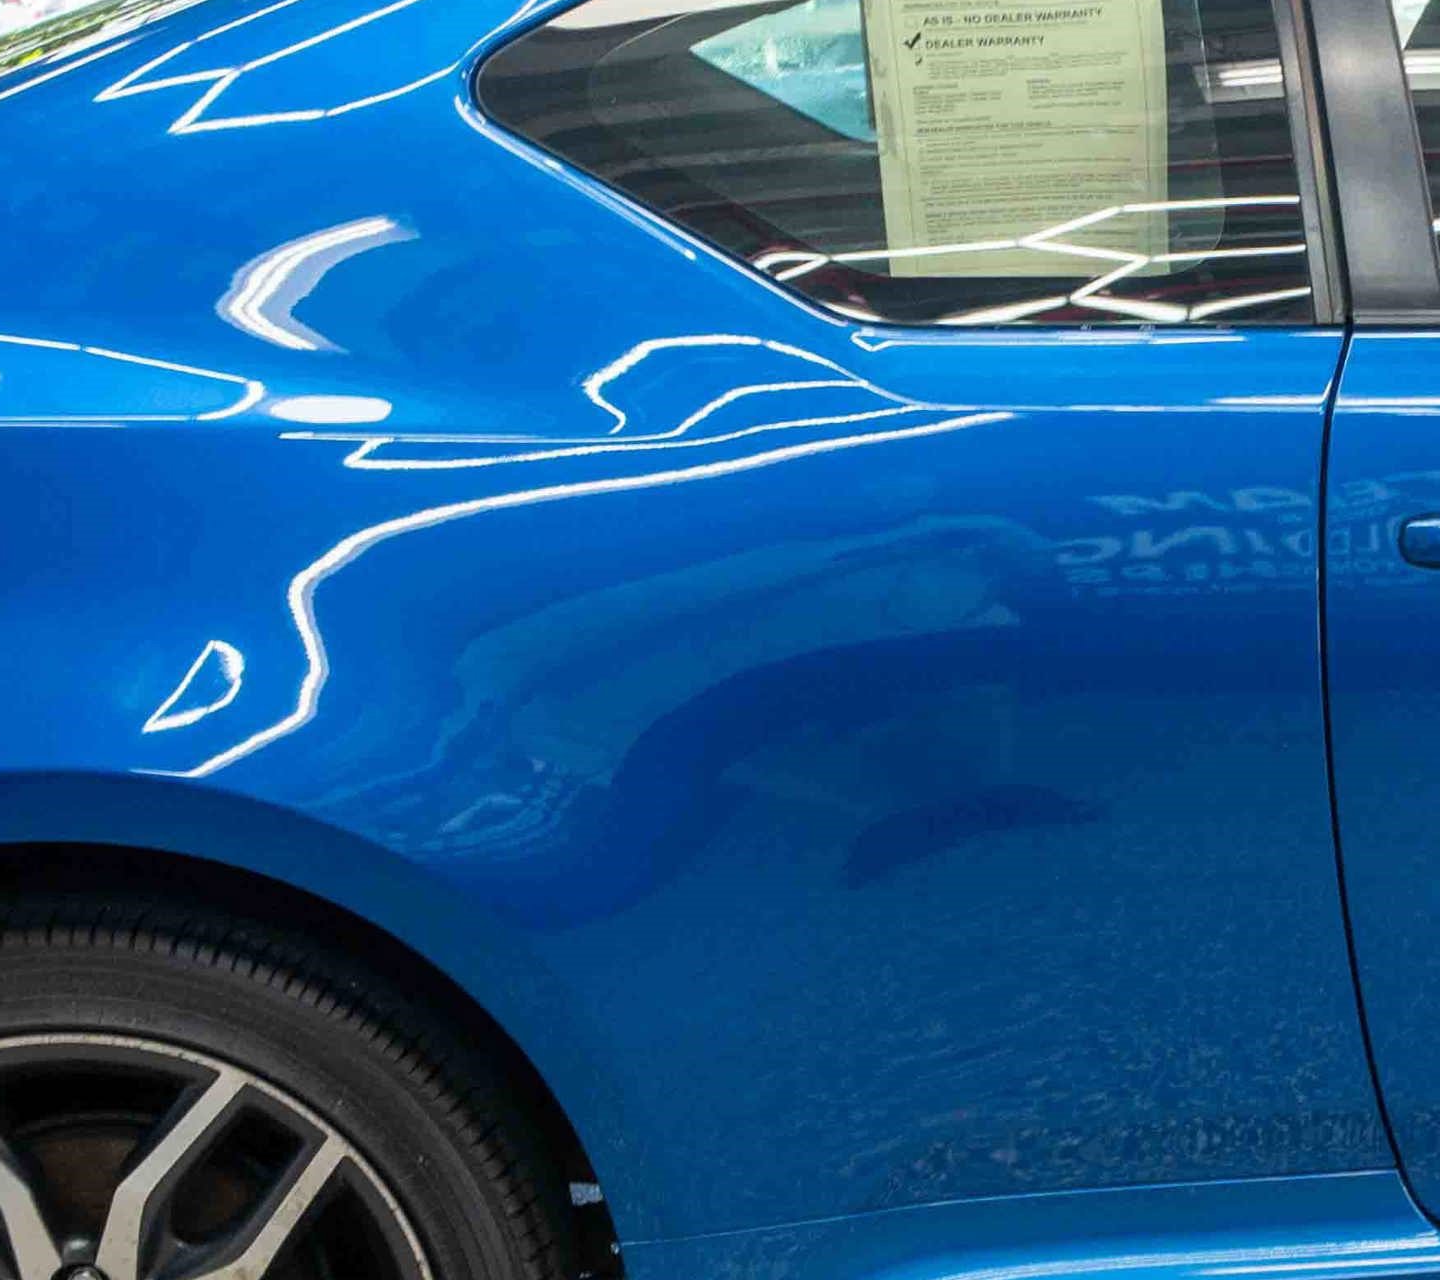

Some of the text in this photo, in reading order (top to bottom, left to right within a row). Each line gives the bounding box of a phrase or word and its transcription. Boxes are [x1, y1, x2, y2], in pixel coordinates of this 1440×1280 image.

[923, 16, 939, 26] AS
[942, 16, 954, 25] IS
[963, 14, 981, 25] NO
[984, 12, 1033, 24] DEALER
[1035, 7, 1103, 22] WARRANTY
[925, 35, 1045, 50] DEALER WARRANTY
